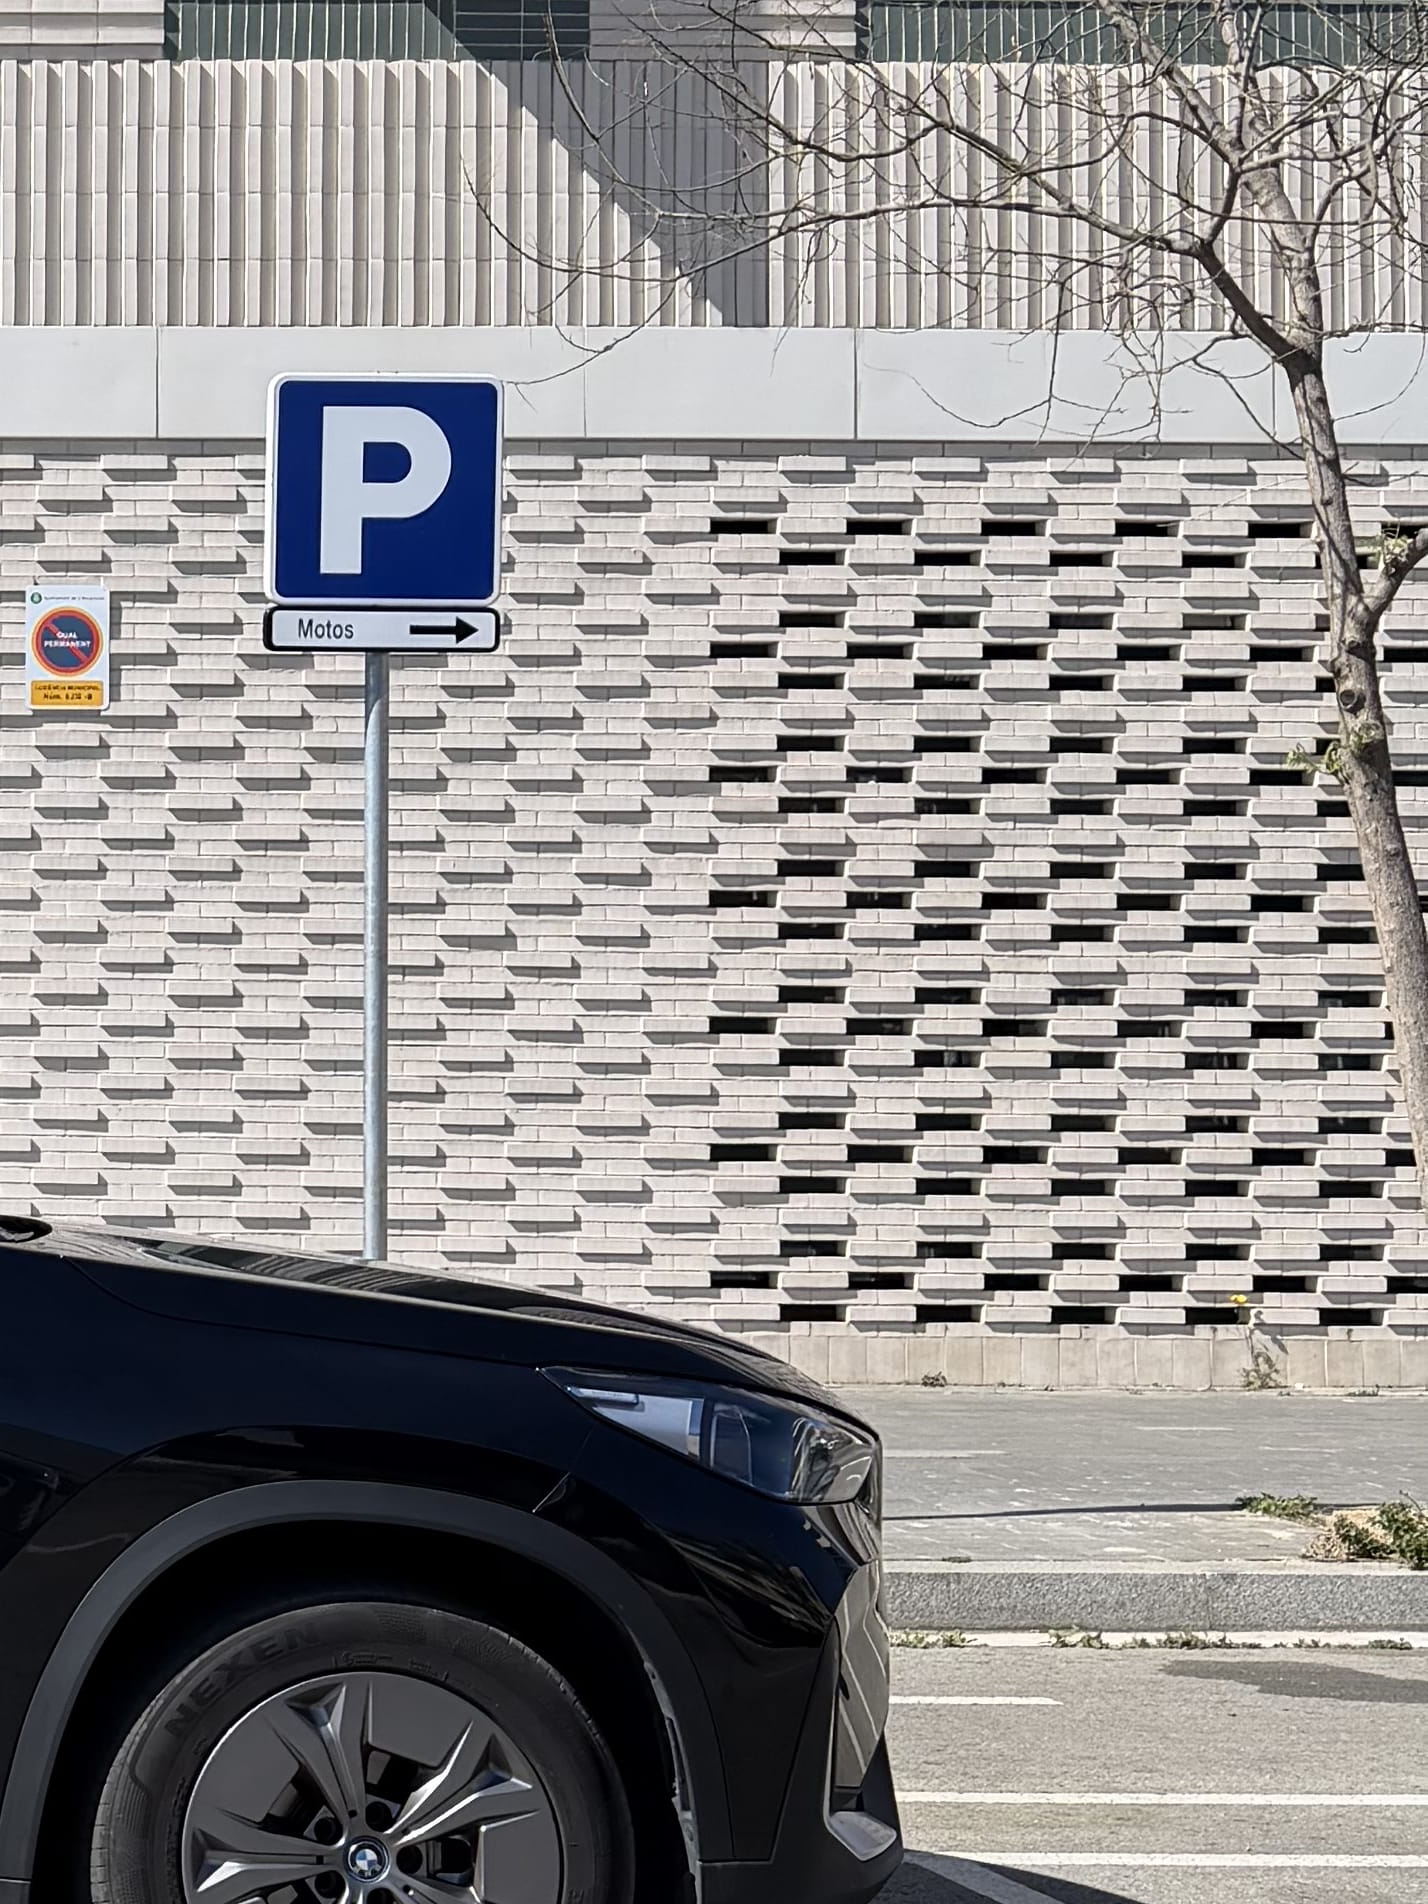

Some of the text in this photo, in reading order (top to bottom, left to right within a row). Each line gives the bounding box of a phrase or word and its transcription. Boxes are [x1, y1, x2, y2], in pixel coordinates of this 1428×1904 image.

[319, 405, 452, 574] P
[297, 617, 354, 640] Motos
[164, 1621, 323, 1738] NEXEN
